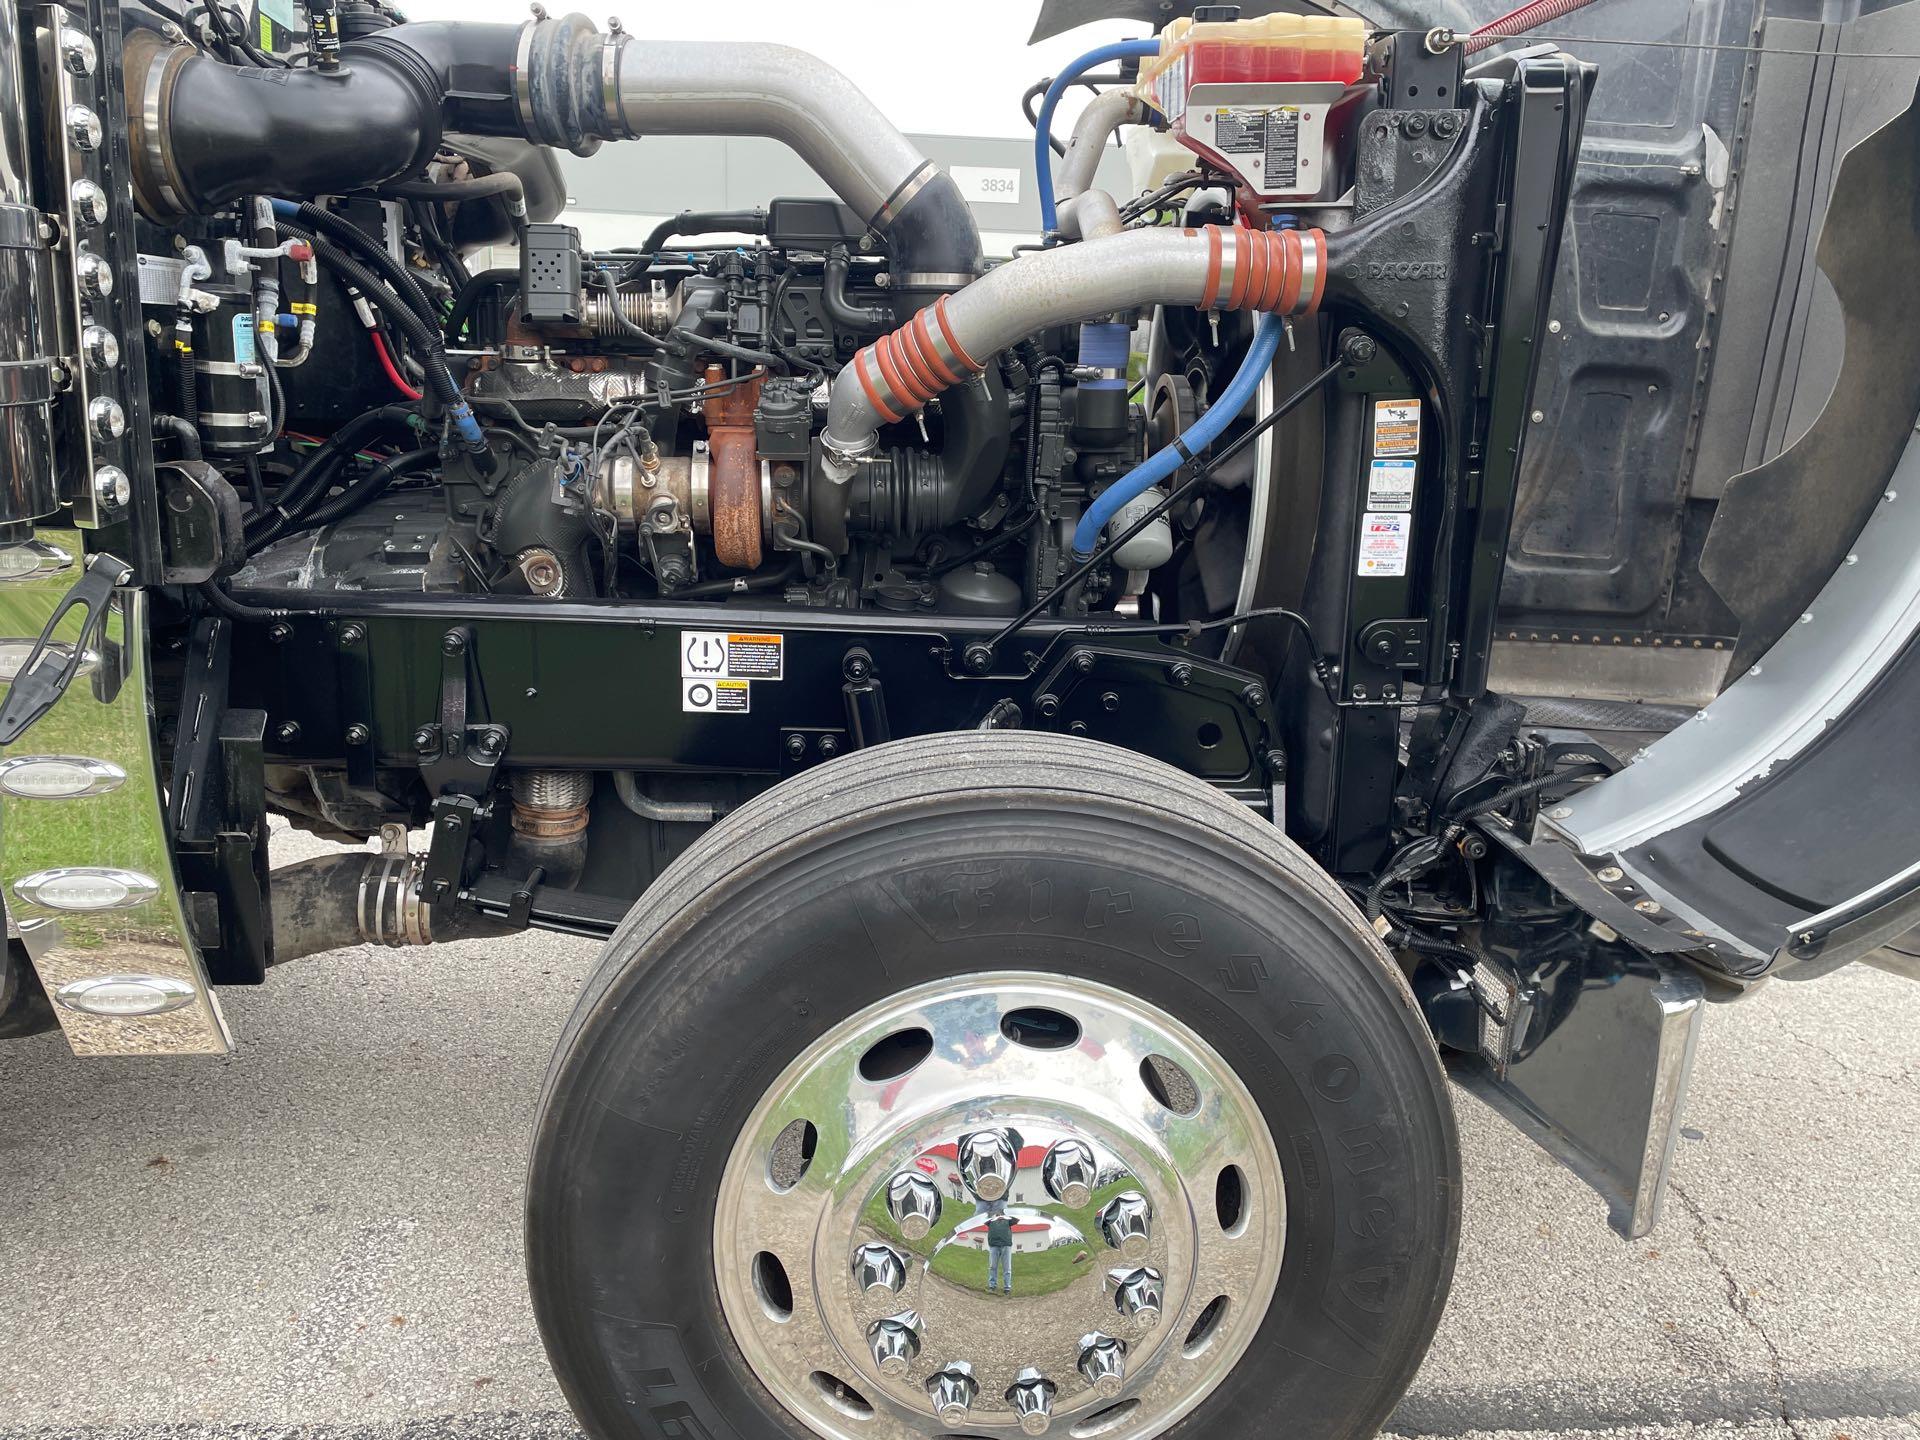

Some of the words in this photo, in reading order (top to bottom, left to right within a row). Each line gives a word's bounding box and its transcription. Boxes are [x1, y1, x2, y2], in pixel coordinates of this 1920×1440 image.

[981, 178, 1014, 193] 3834
[1366, 261, 1447, 281] PACCAR
[944, 868, 1397, 1242] Firestone
